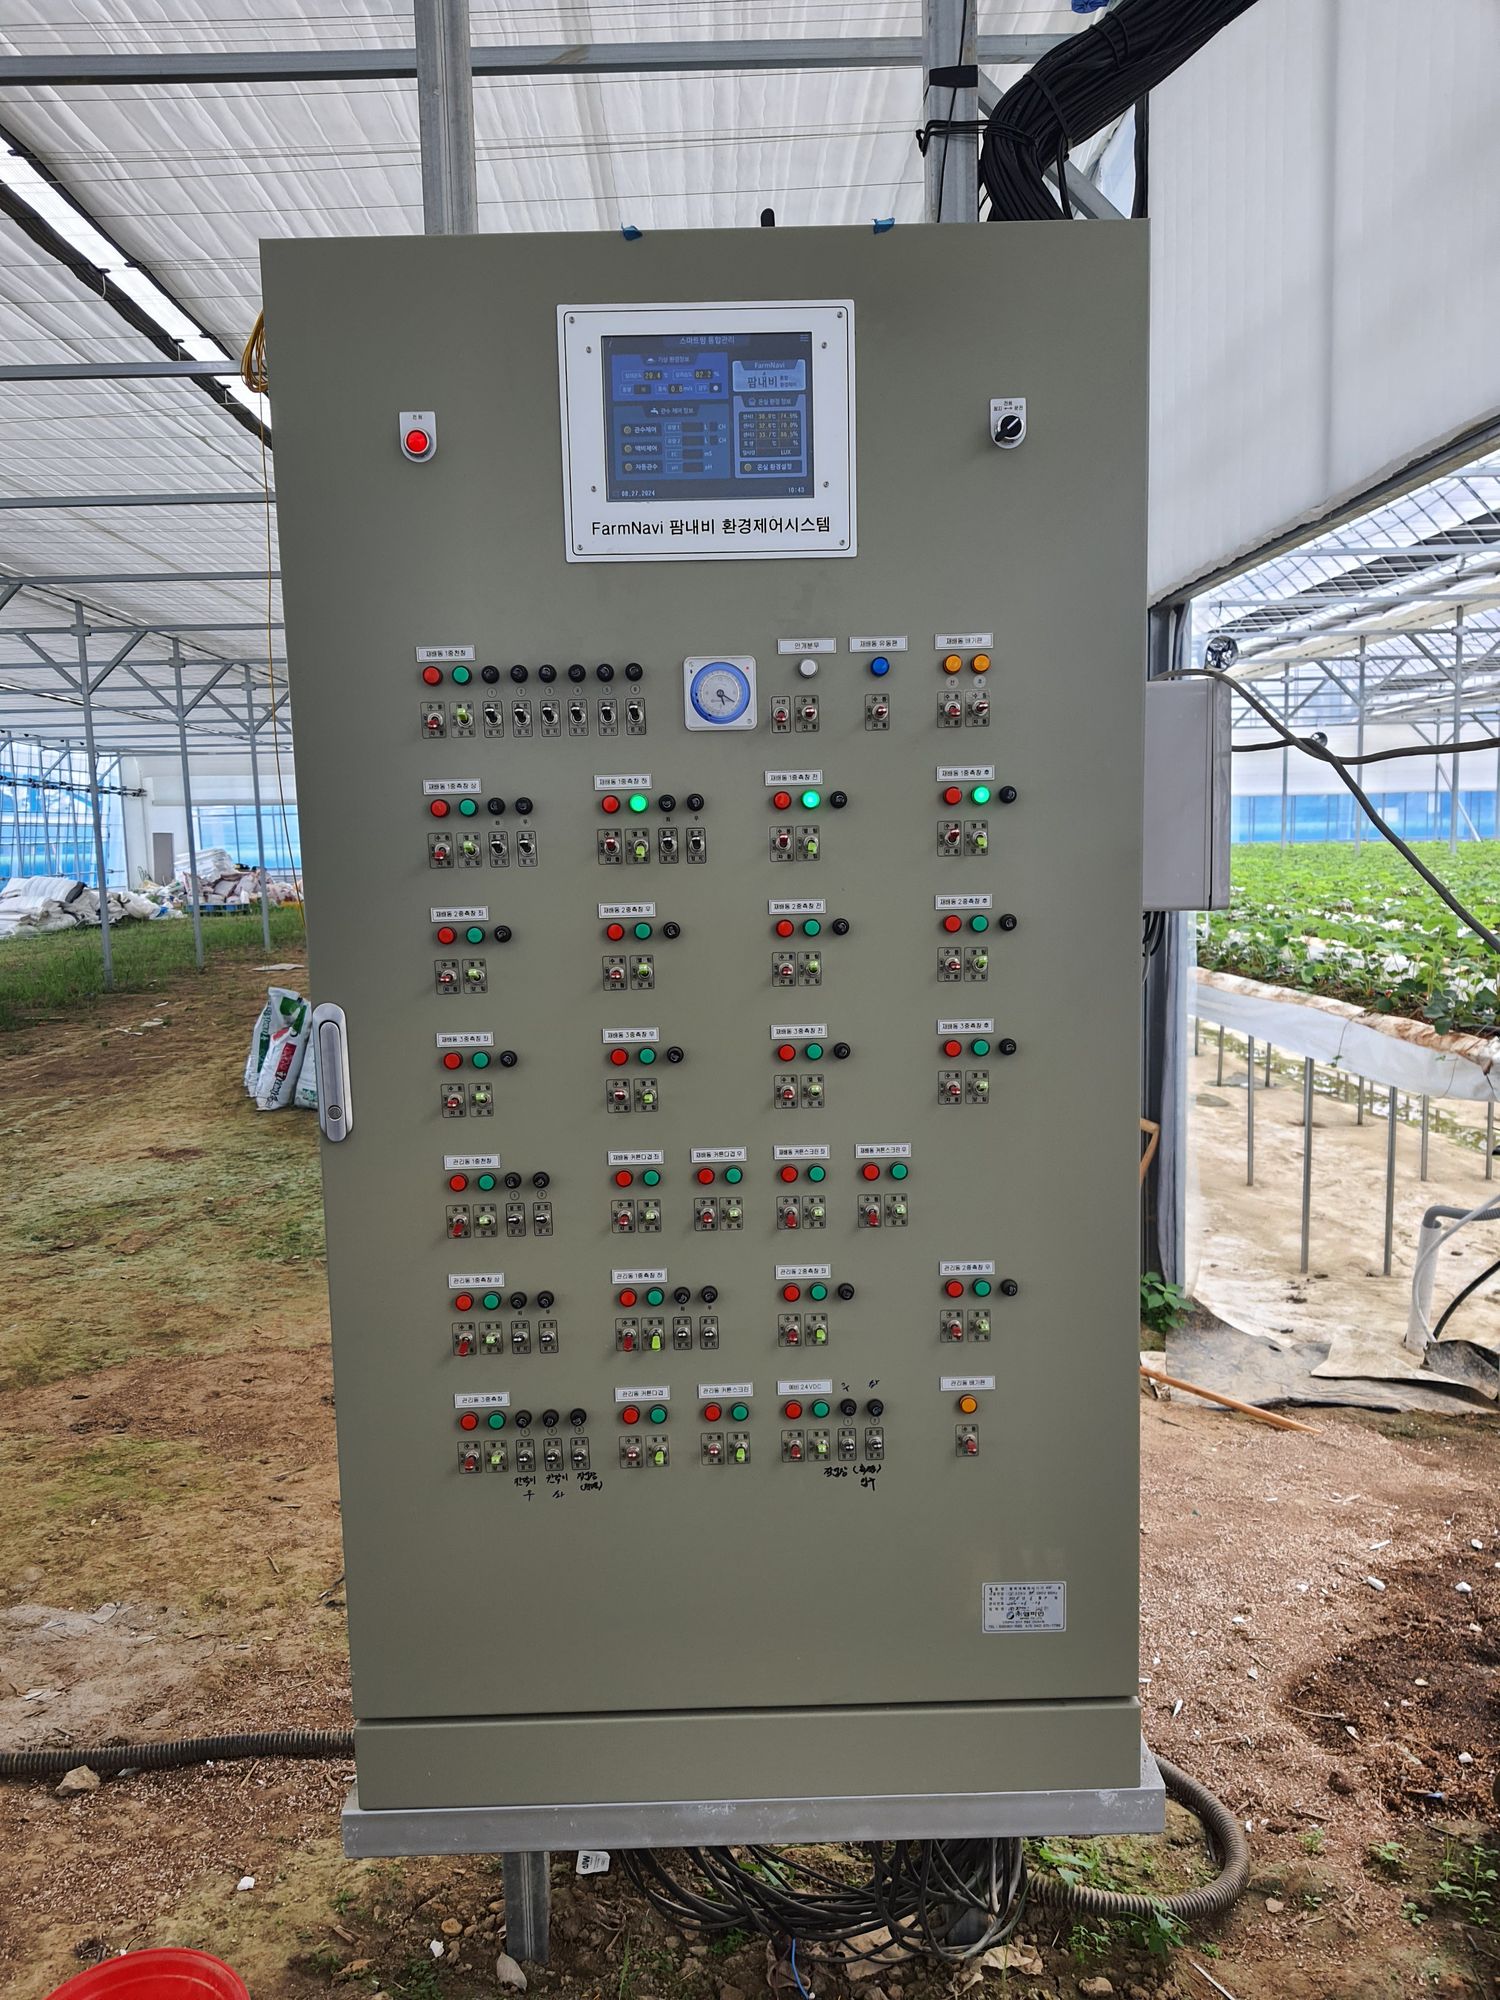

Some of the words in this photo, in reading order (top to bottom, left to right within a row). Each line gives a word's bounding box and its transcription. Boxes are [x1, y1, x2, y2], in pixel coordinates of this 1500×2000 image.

[747, 375, 778, 389] 팜내비
[592, 521, 664, 535] FarmNavi
[669, 519, 715, 535] 팜내비
[721, 516, 831, 535] 환경제어시스템
